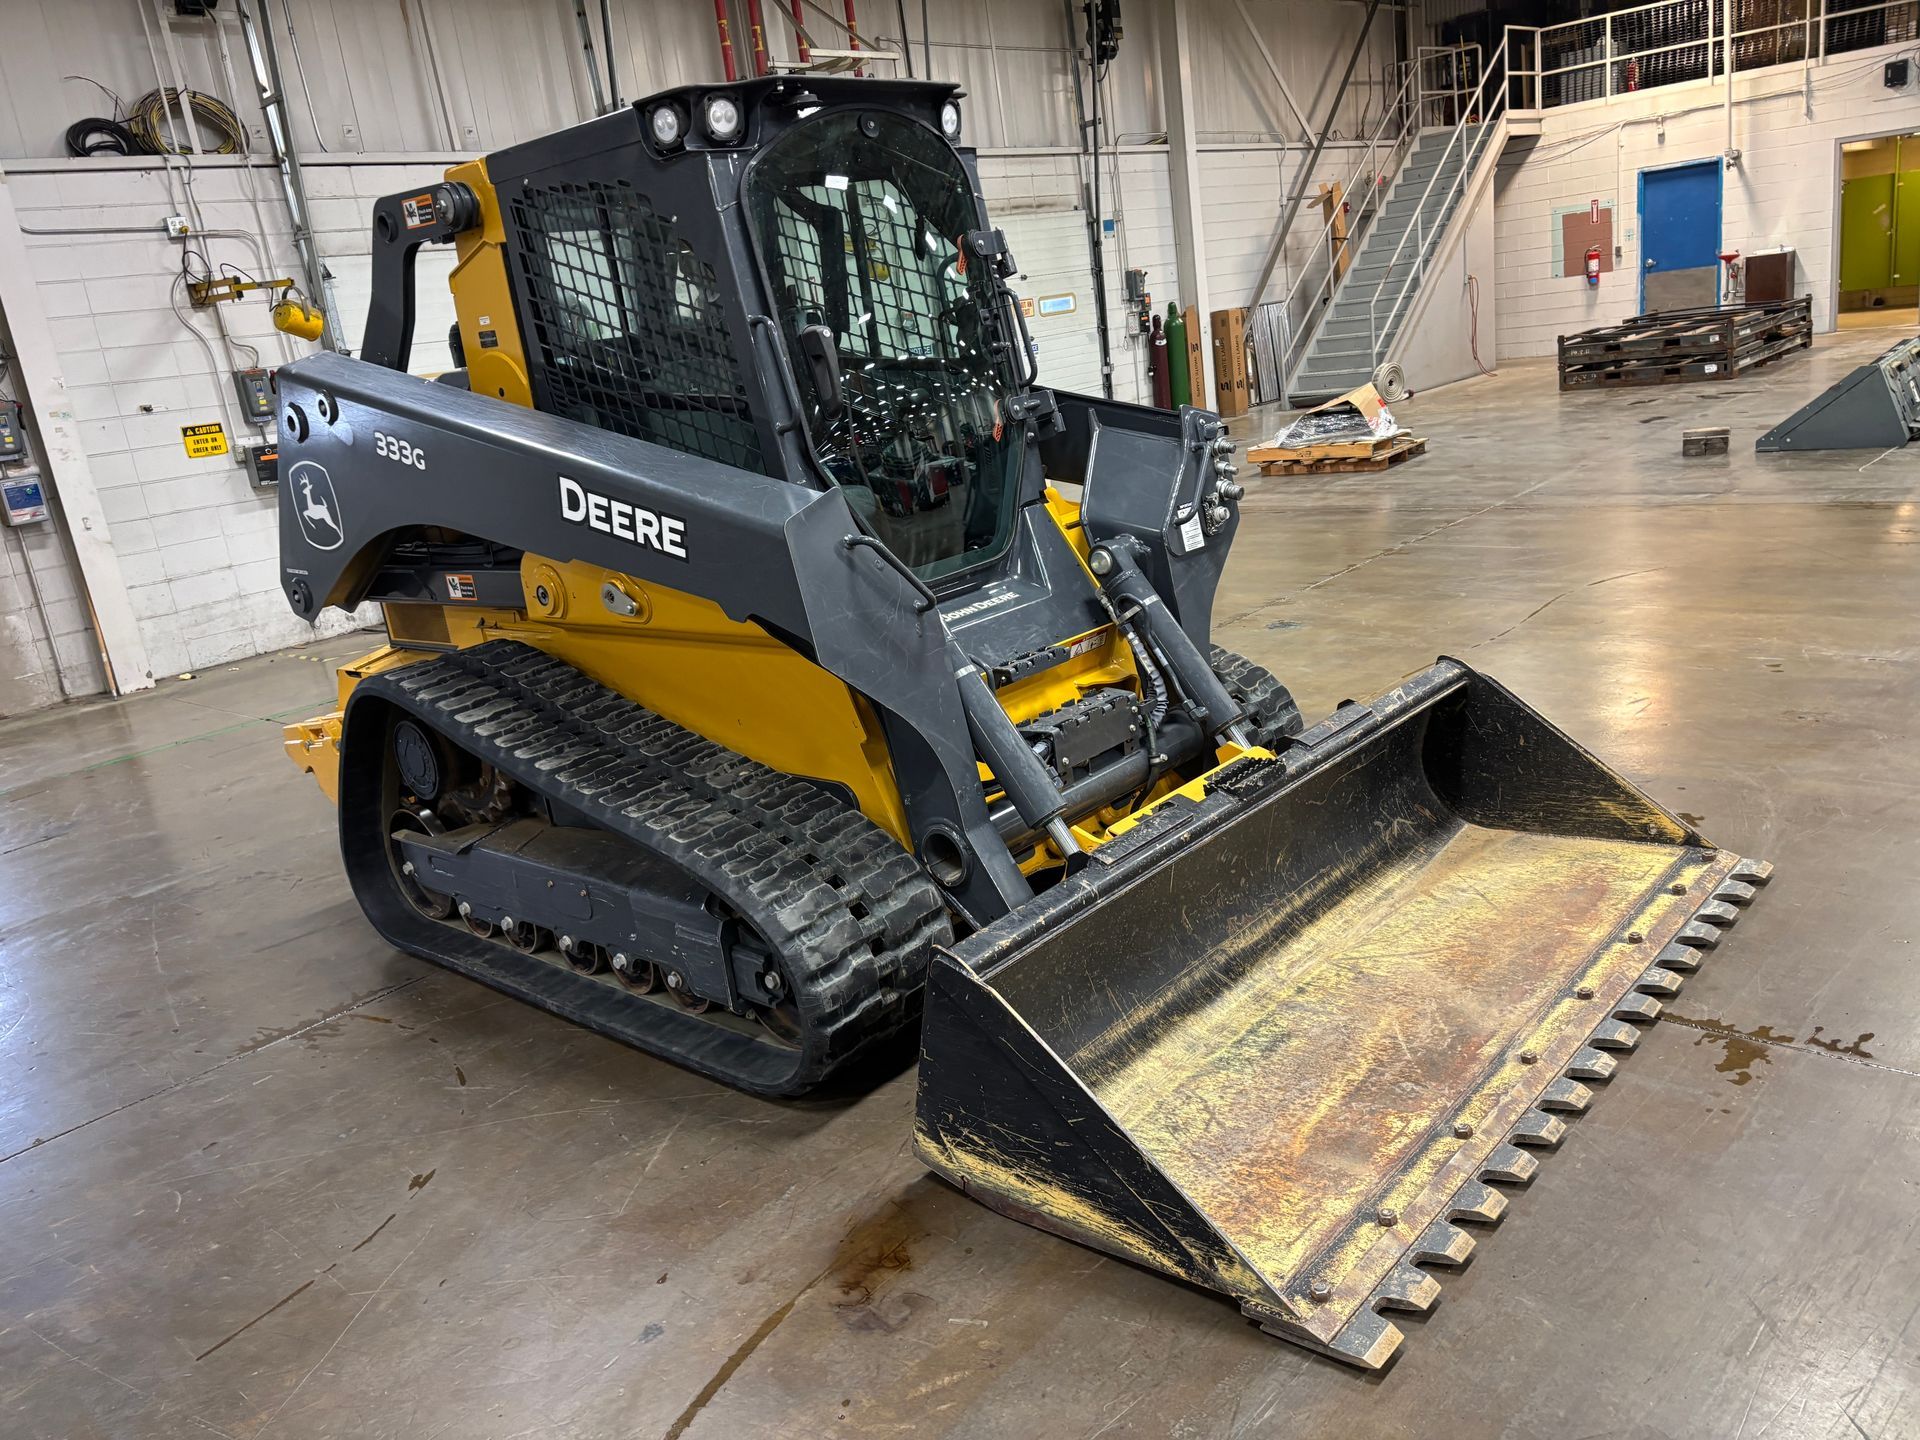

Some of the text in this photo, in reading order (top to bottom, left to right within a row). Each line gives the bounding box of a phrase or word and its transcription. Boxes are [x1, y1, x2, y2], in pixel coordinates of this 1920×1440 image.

[195, 425, 220, 435] CAUTION
[192, 446, 209, 454] GREEN
[374, 431, 426, 470] 333G
[558, 476, 687, 559] DEERE
[941, 591, 1020, 622] JOHN DEERE
